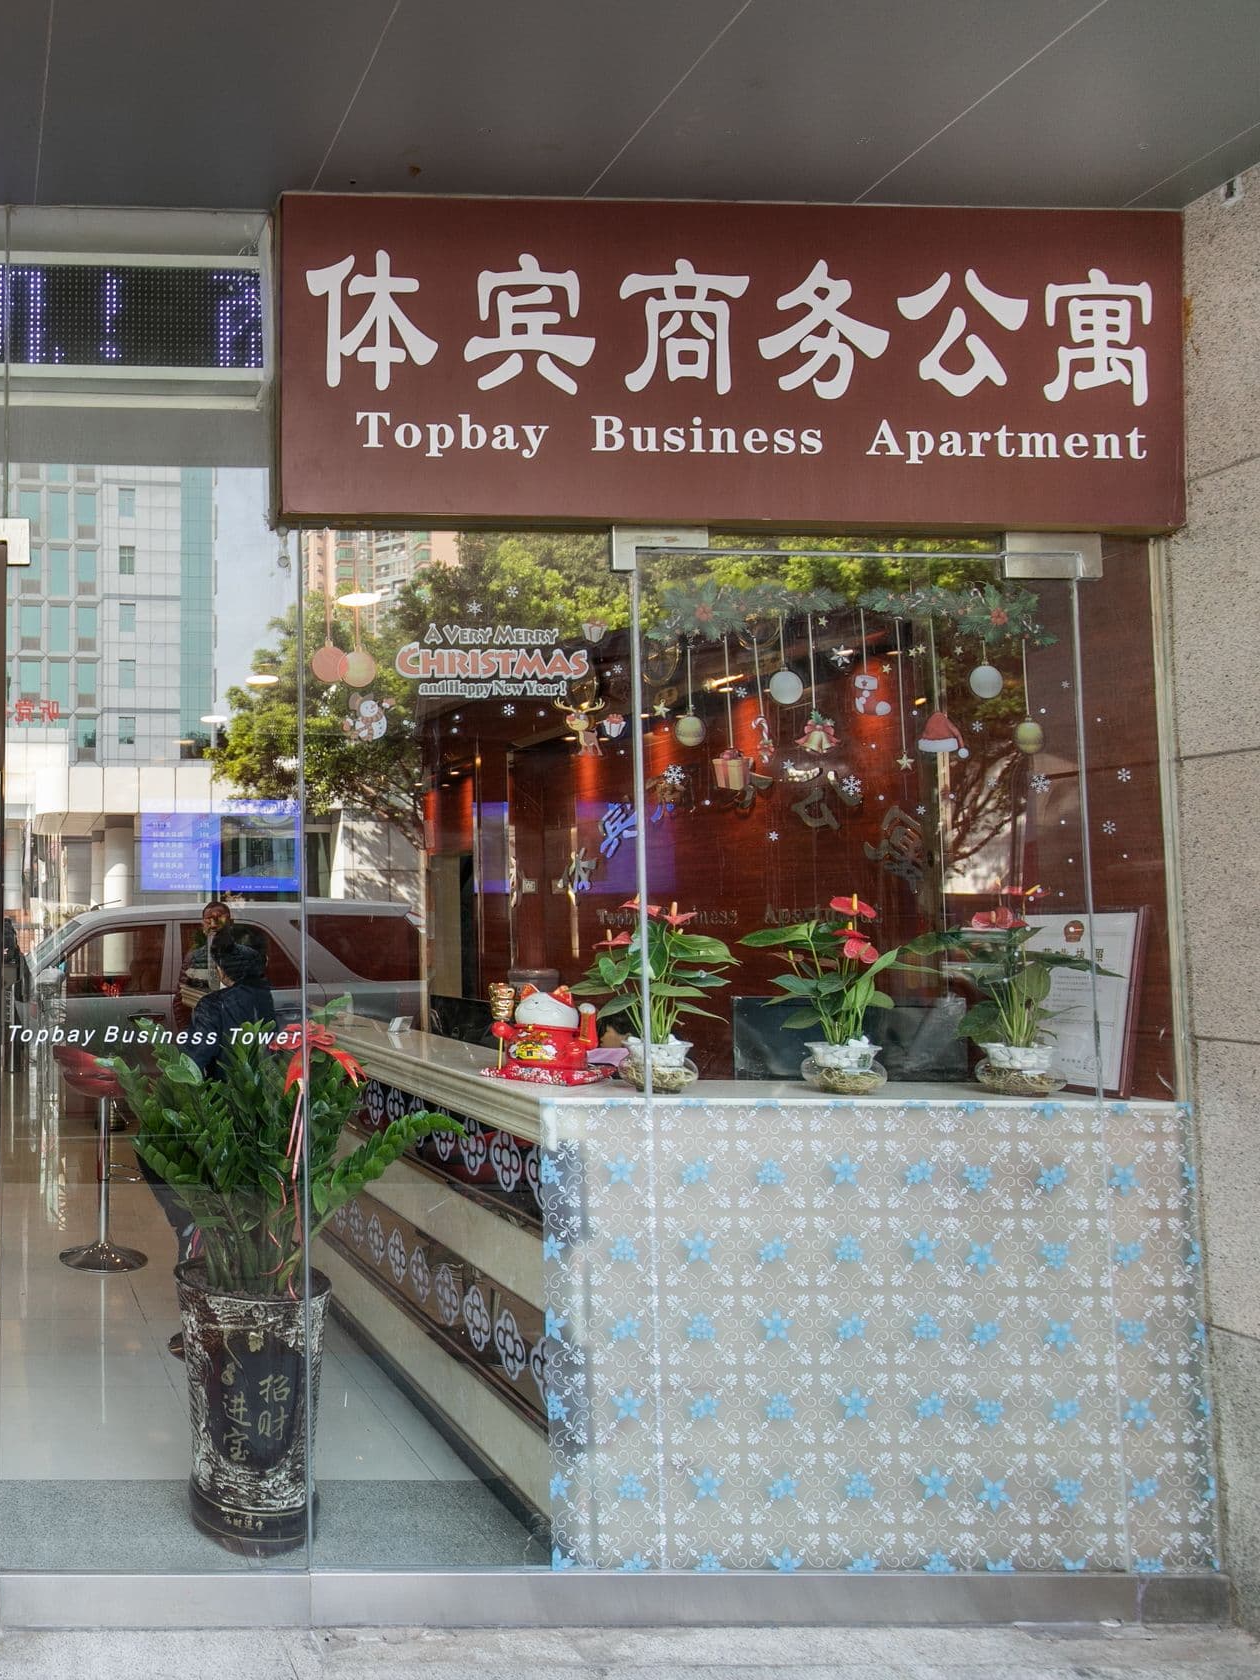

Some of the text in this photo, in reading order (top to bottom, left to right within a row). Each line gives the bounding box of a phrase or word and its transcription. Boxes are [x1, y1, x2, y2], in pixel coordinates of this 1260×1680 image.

[305, 248, 1153, 406] 体宾商务公寓
[355, 411, 1149, 464] Topbay Business Apartment
[424, 623, 442, 645] A
[395, 641, 590, 680] CHRISTMAS
[419, 680, 448, 696] and
[448, 680, 492, 698] Happy
[492, 680, 524, 697] New
[8, 1024, 301, 1047] Topbay Business Tower
